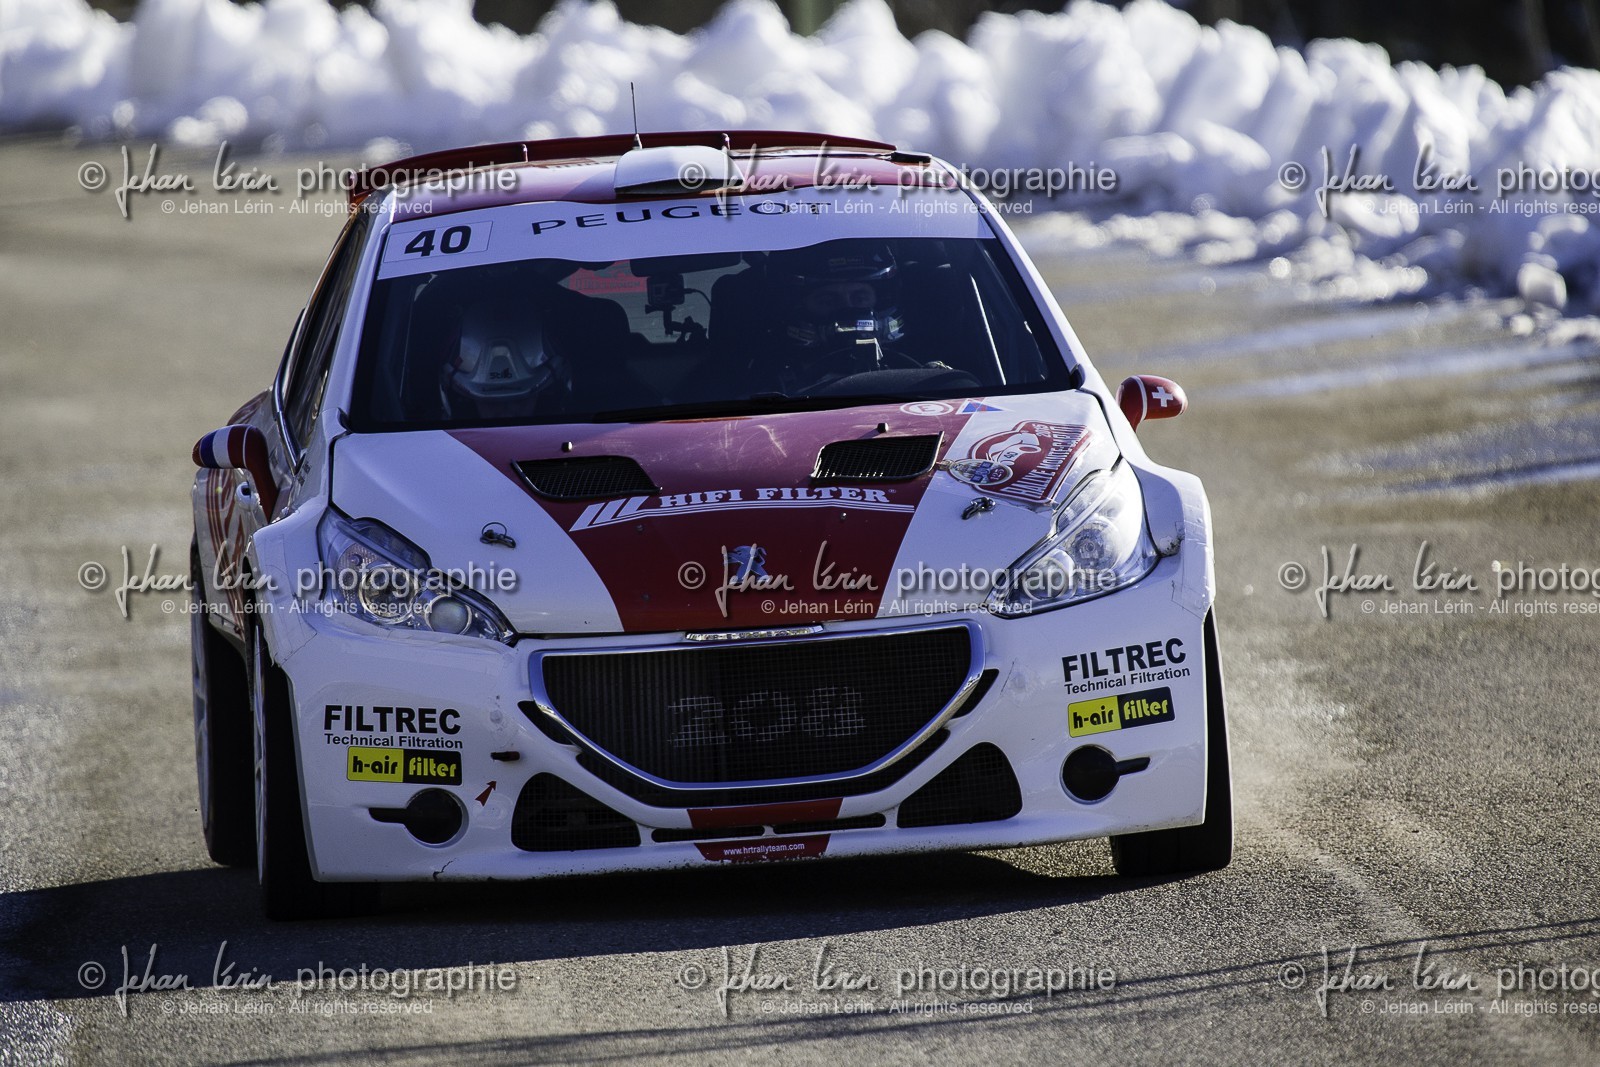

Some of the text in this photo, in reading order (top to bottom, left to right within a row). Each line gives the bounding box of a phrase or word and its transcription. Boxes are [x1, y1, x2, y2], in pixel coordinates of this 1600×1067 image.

[532, 202, 832, 236] PEUGEOT
[404, 225, 471, 257] 40
[659, 489, 742, 507] HIFI
[1062, 638, 1187, 682] FILTREC
[1064, 667, 1190, 694] Technical Filtration
[324, 705, 461, 735] FILTREC
[1073, 698, 1168, 729] h-air filter
[324, 733, 463, 749] Technical Filtration
[352, 755, 457, 777] h-air filter
[723, 842, 805, 856] www.hrtrallyteam.com
